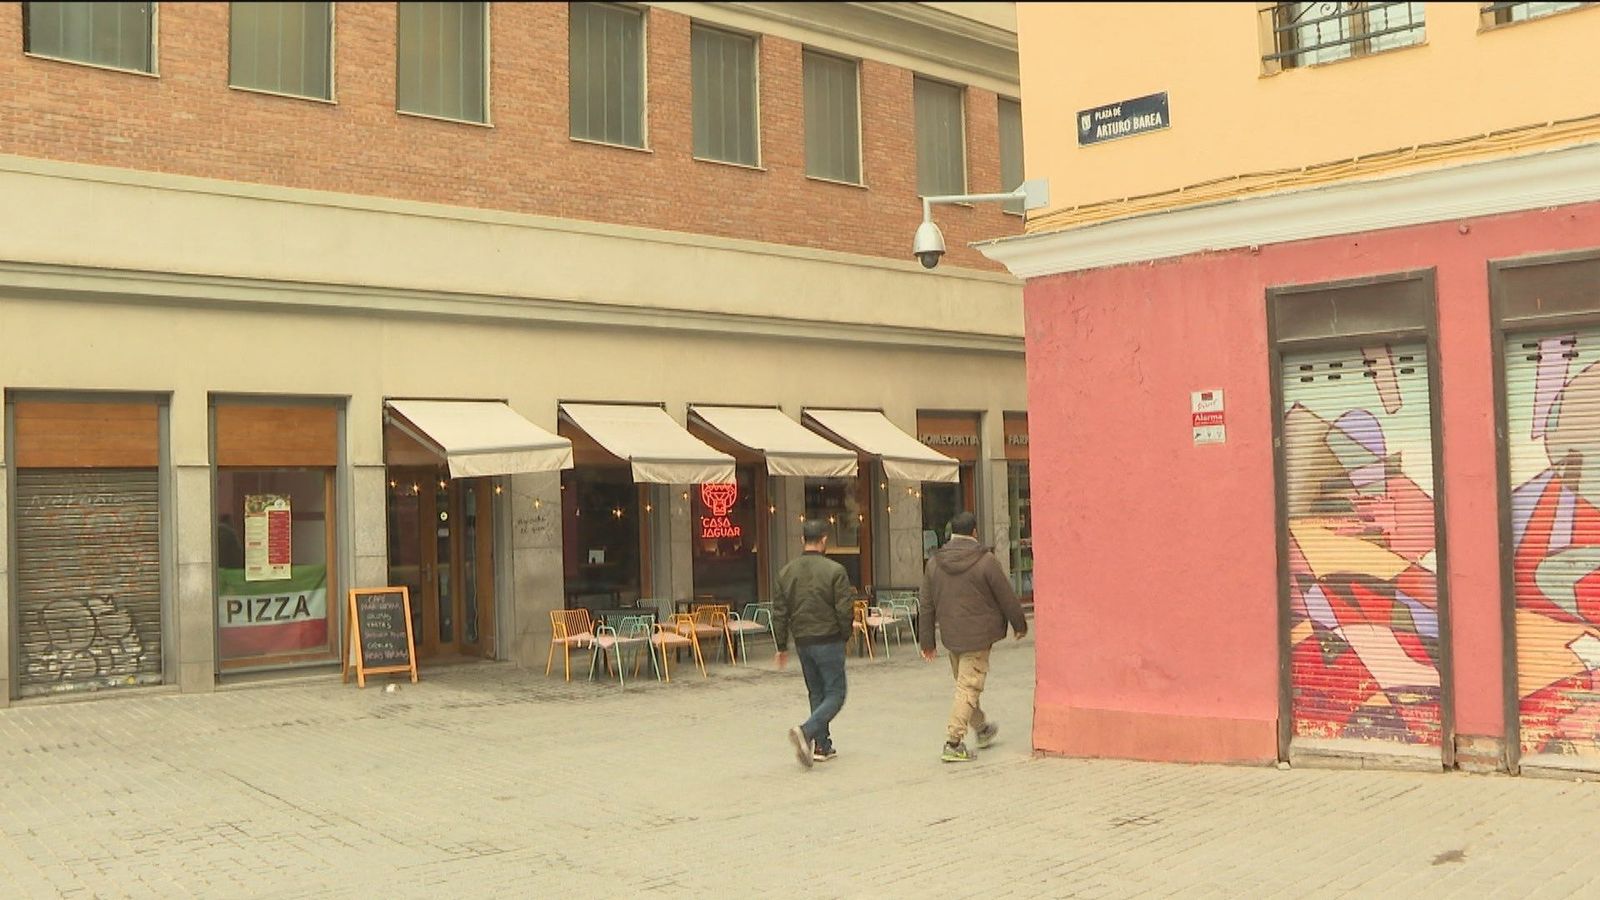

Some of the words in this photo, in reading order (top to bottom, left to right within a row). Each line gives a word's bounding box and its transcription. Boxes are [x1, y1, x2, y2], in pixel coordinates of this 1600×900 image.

[1095, 108, 1112, 121] PLAZA
[1113, 107, 1121, 117] DE
[1097, 119, 1130, 138] ARTURO
[1133, 112, 1162, 130] BAREA
[702, 517, 731, 528] CASA
[702, 526, 741, 538] JAGUAR
[226, 595, 310, 624] PIZZA
